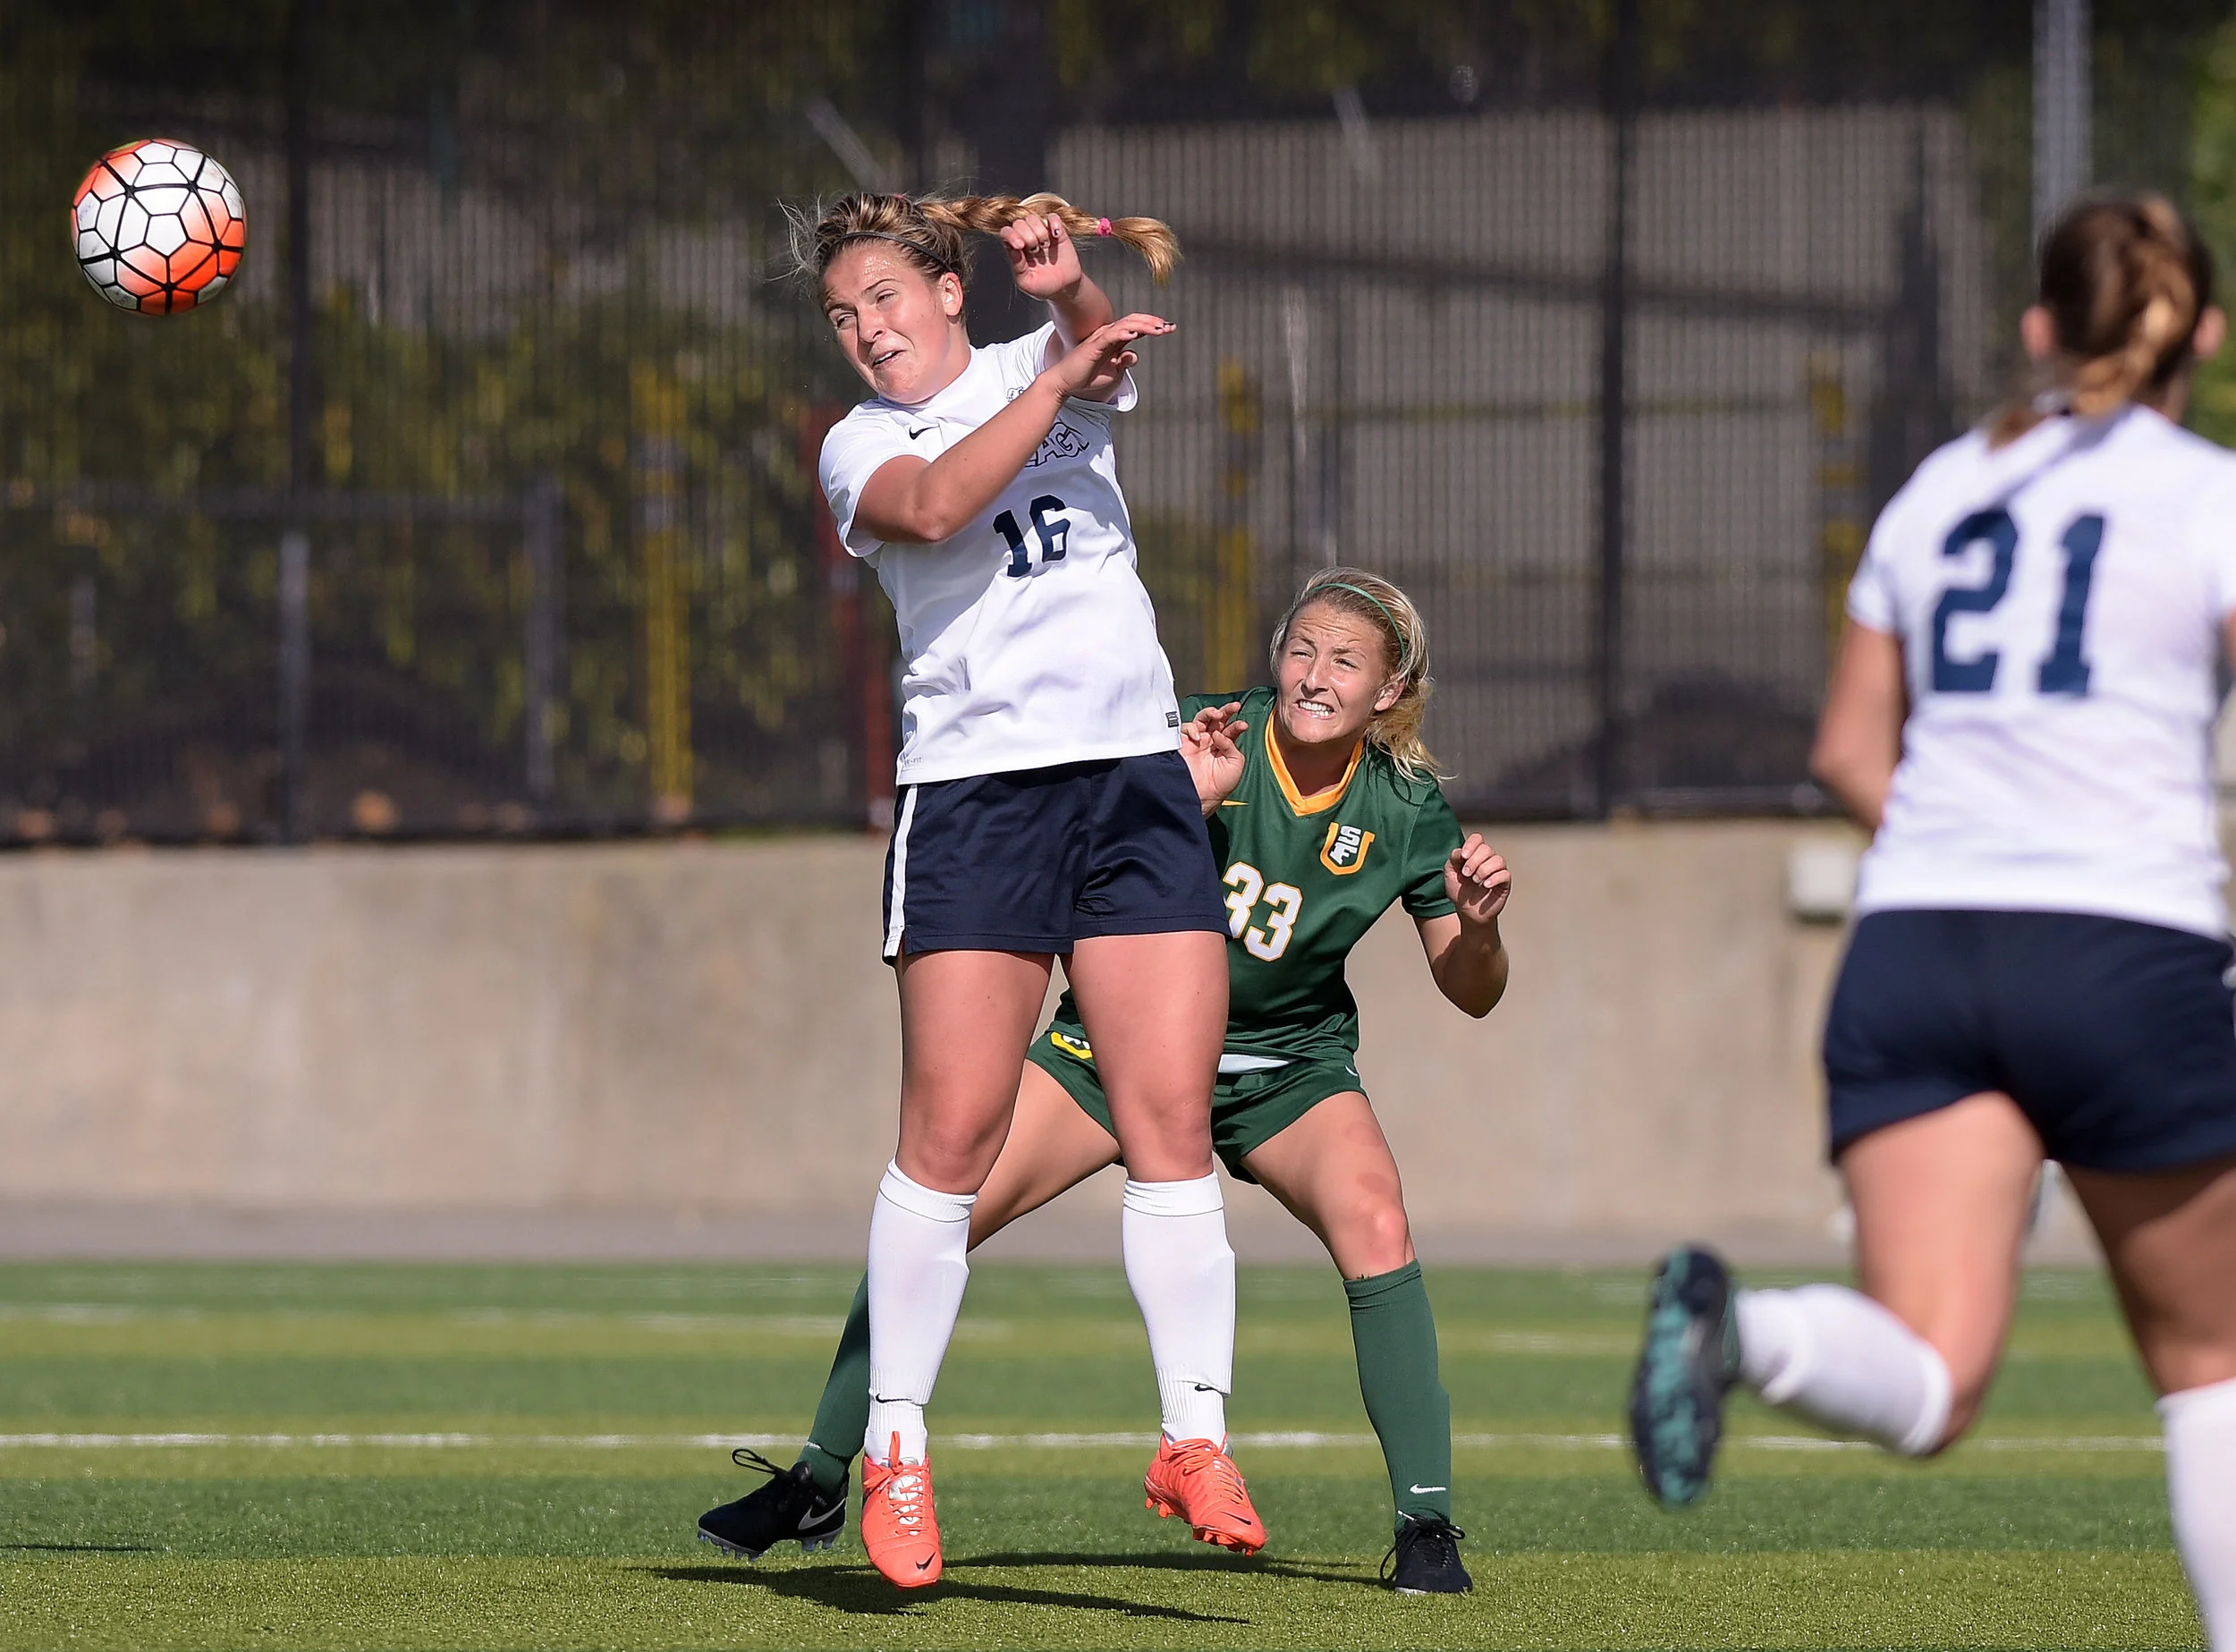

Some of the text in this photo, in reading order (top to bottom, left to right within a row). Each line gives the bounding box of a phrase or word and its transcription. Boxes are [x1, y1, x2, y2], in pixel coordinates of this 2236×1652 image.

[1024, 421, 1089, 468] AG
[993, 495, 1071, 577] 16
[1933, 508, 2105, 696] 21
[1223, 861, 1303, 962] 33
